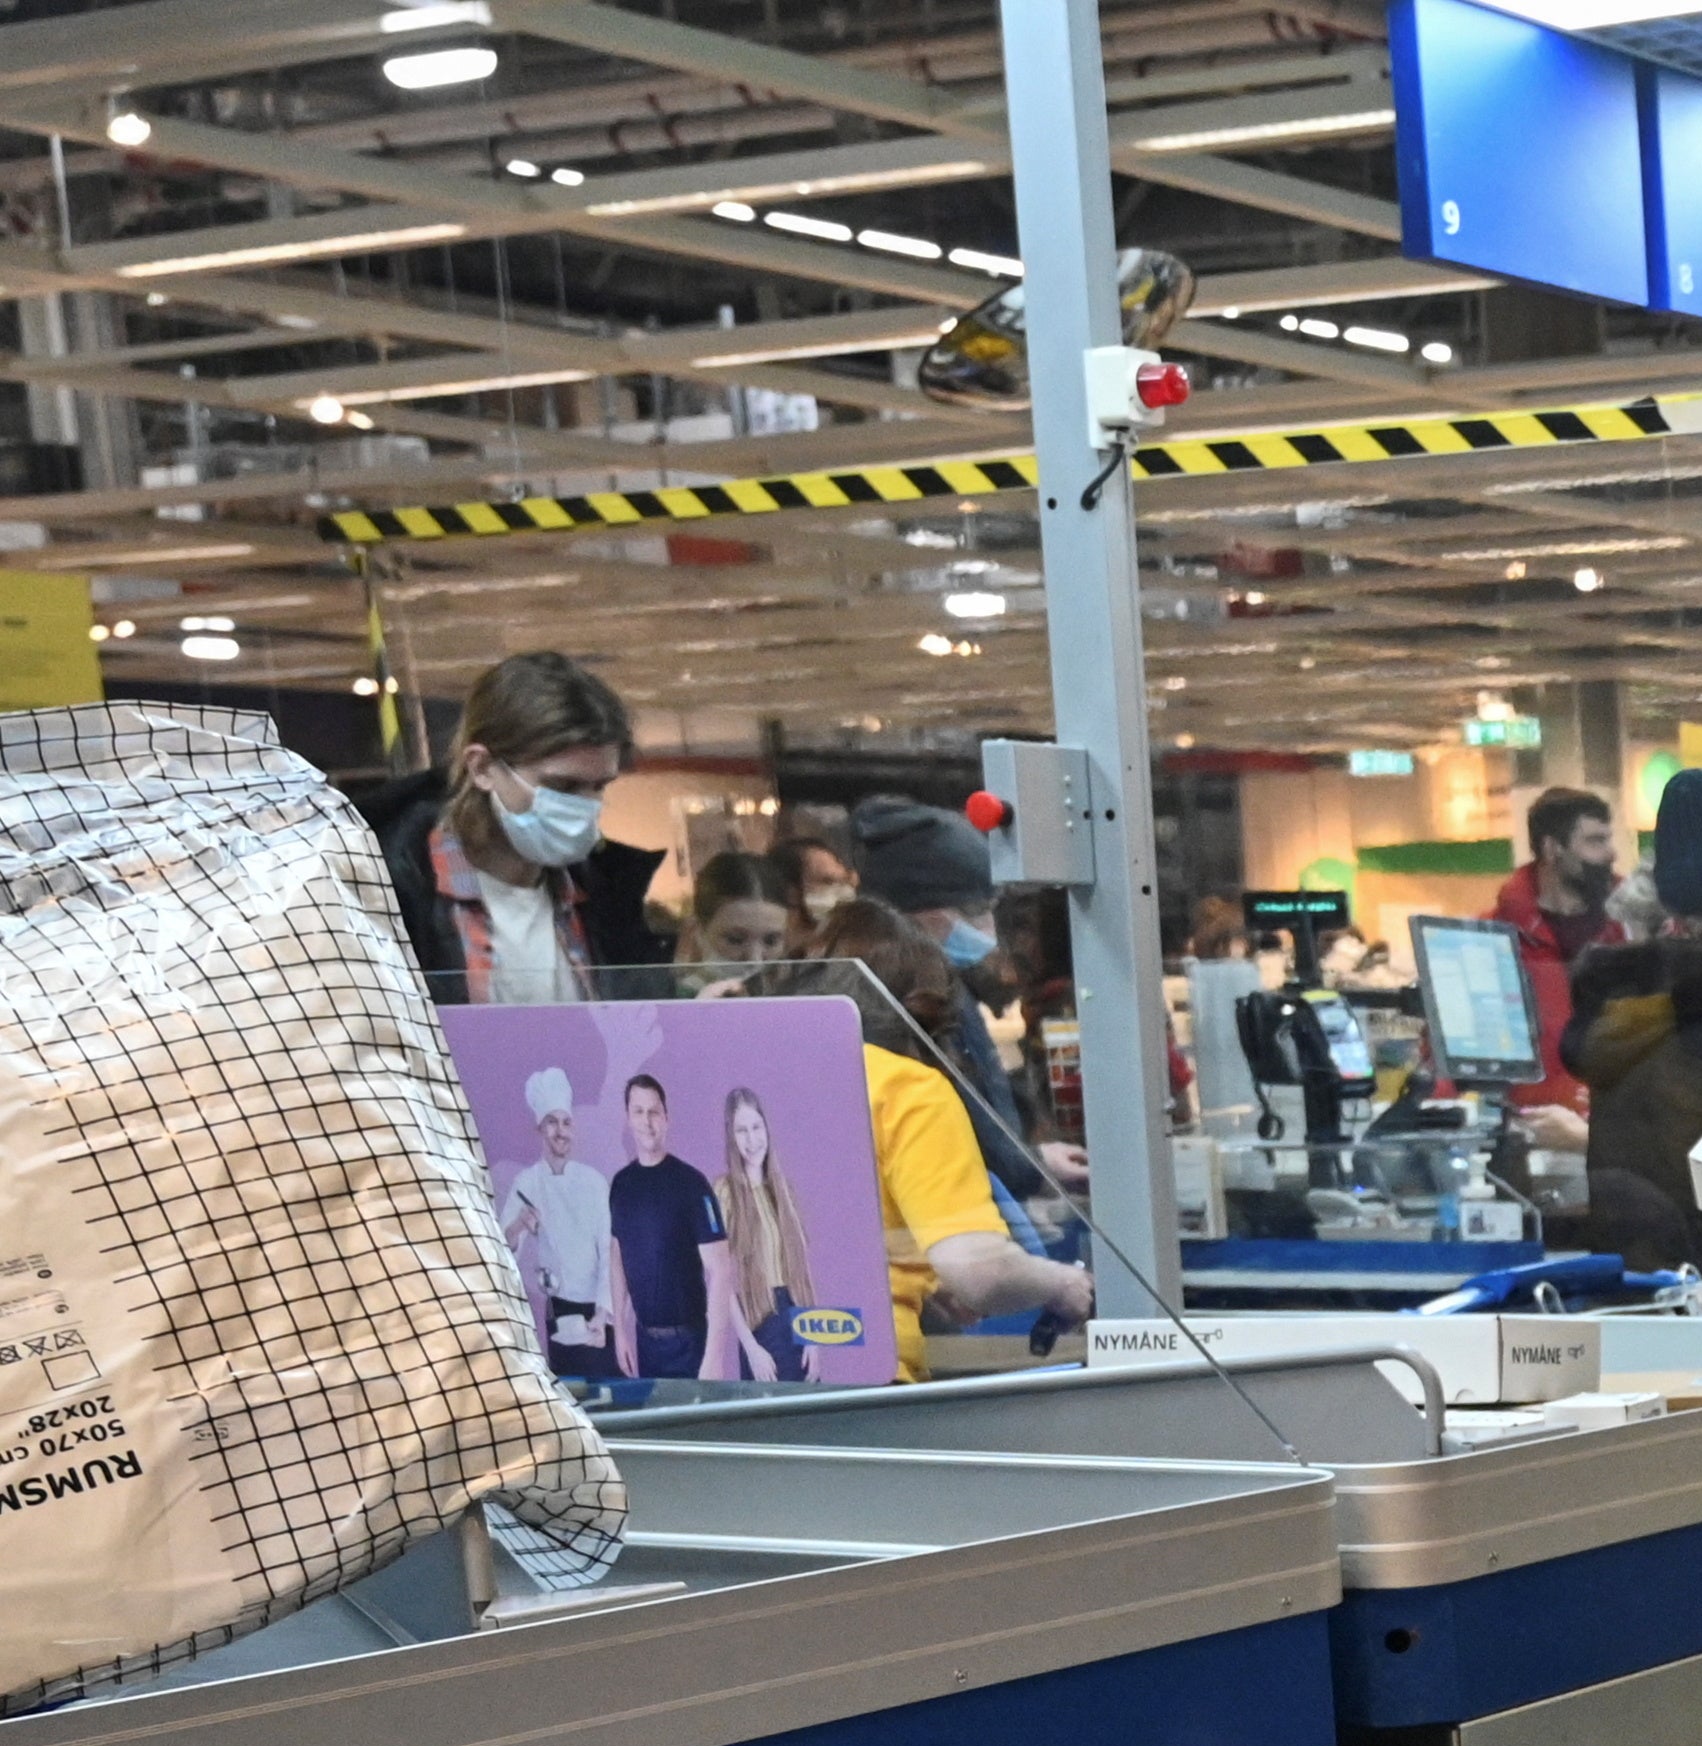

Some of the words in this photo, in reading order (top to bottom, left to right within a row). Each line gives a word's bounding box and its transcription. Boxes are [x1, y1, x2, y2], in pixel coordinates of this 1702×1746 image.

[1442, 199, 1461, 237] 9
[799, 1318, 857, 1334] IKEA
[1095, 1330, 1177, 1351] NYMÅNE
[1512, 1344, 1562, 1365] NYMÅNE
[16, 1395, 115, 1438] 20x28"
[38, 1418, 127, 1458] 50x70
[0, 1445, 30, 1467] cm
